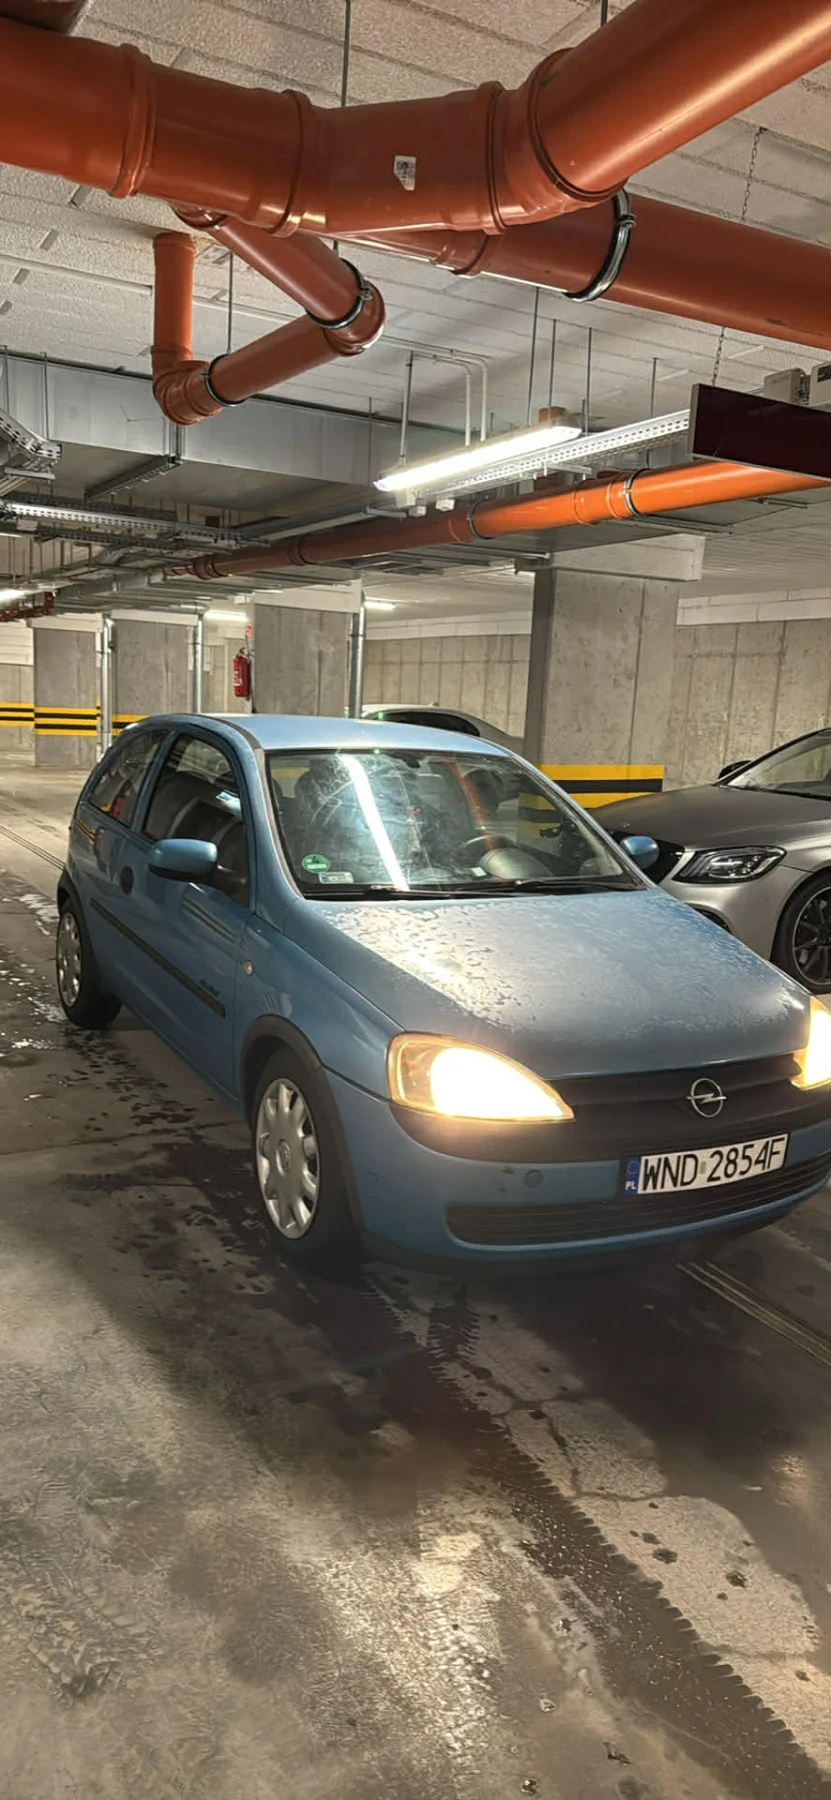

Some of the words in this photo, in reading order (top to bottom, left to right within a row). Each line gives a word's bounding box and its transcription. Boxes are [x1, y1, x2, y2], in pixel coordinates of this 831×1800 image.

[642, 1153, 699, 1191] WND
[706, 1138, 785, 1182] 2854F
[625, 1181, 637, 1190] PL
